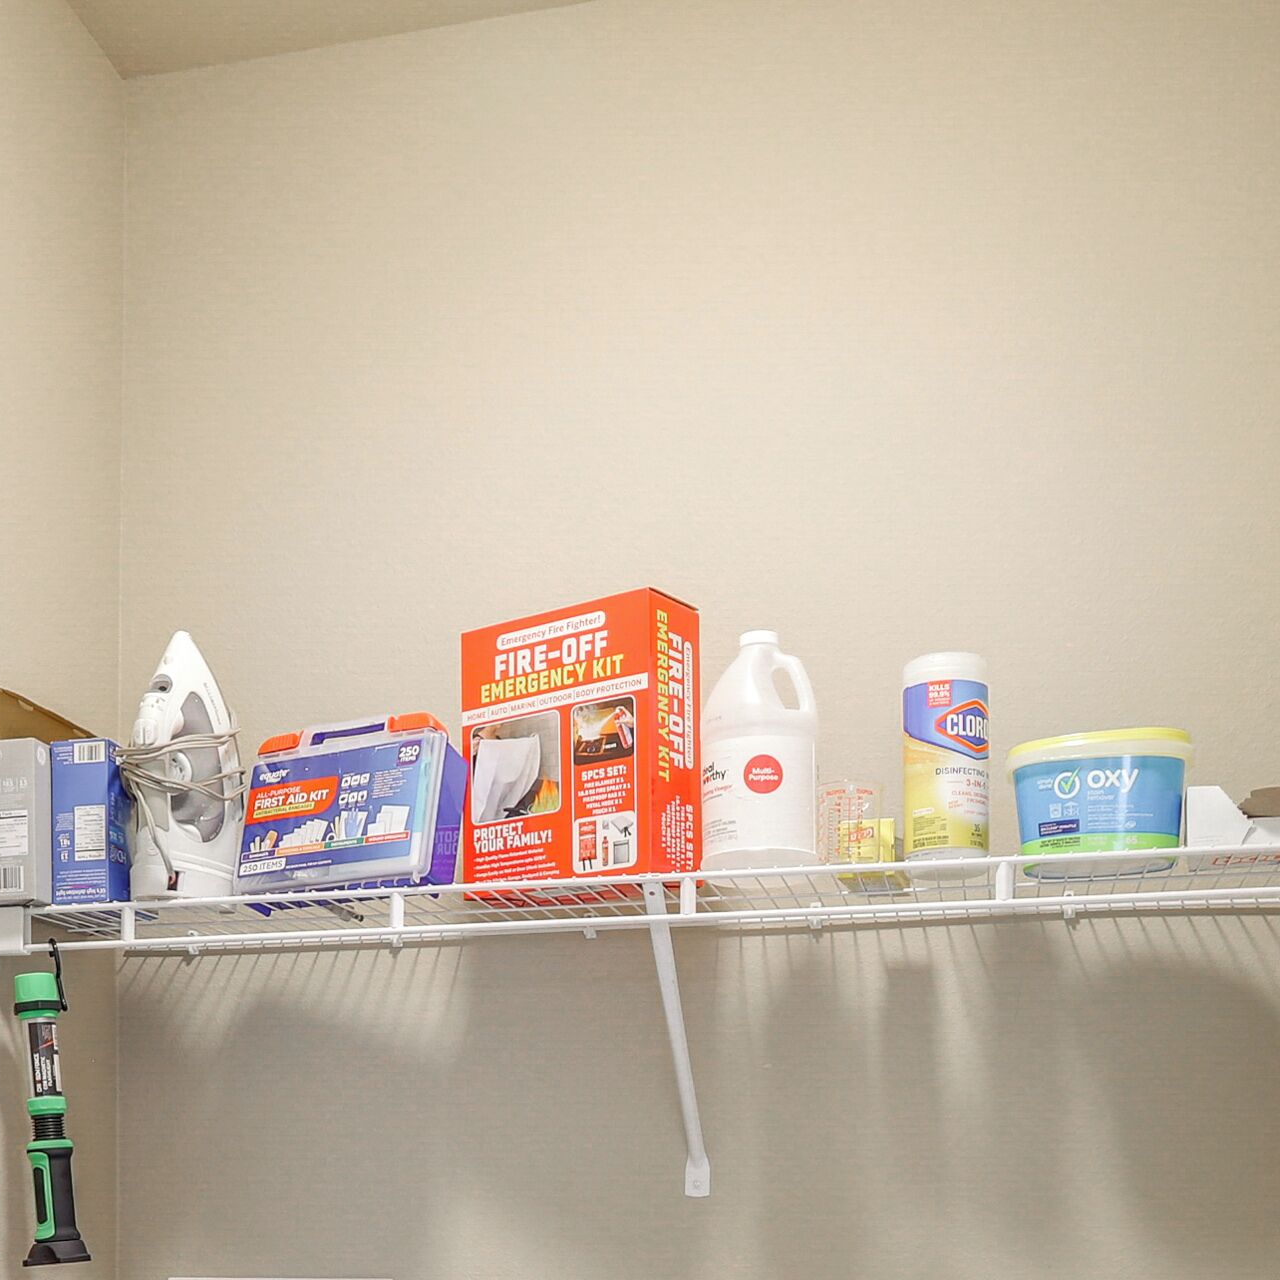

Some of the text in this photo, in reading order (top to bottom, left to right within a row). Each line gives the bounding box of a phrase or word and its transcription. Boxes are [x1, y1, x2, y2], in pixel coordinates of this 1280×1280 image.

[501, 615, 601, 646] Emergency Fire Fighter!
[495, 630, 608, 681] FIRE-OFF
[481, 653, 624, 704] EMERGENCY KIT
[596, 678, 642, 695] PROTECTION
[657, 609, 670, 782] EMERGENCY KIT
[668, 632, 684, 769] FIRE-OFF
[399, 745, 420, 758] 250
[581, 768, 605, 781] 5PCS
[748, 773, 779, 782] Purpose
[936, 767, 985, 778] DISINFECTING
[1087, 768, 1139, 793] oxy
[254, 789, 329, 810] FIRST AID KIT
[256, 786, 301, 799] ALL-PURPOSE
[473, 822, 524, 842] PROTECT
[473, 829, 552, 854] YOUR FAMILY!
[242, 864, 259, 873] 250
[259, 860, 283, 871] ITEMS
